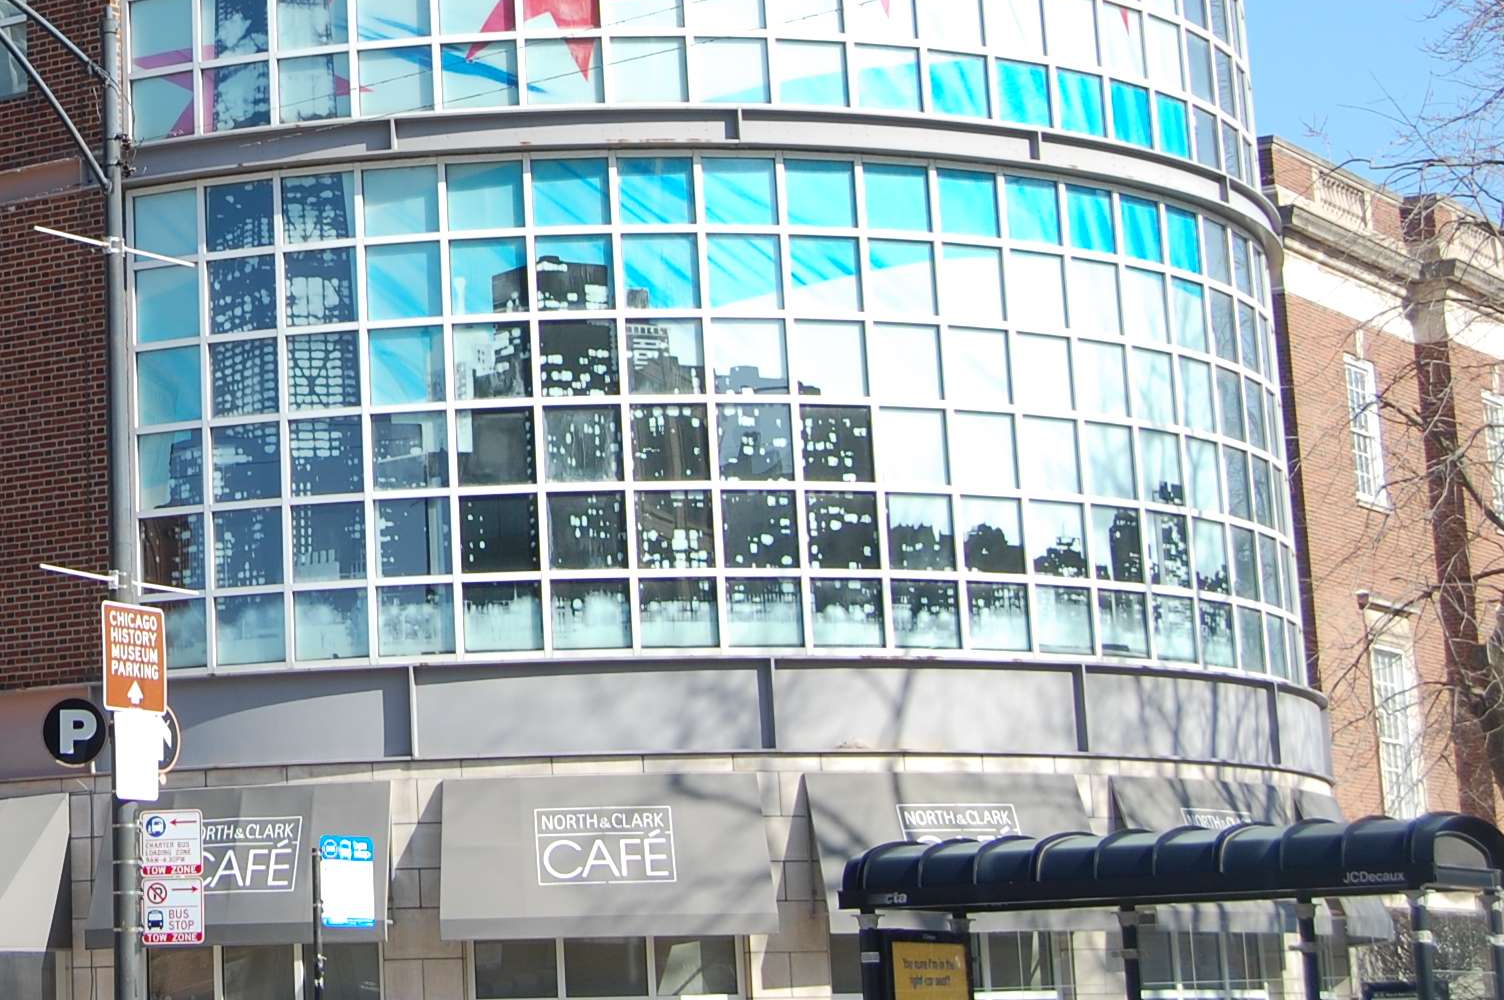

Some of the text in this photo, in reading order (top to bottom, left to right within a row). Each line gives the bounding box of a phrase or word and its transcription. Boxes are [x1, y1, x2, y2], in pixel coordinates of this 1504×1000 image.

[109, 610, 158, 631] CHICAGO
[110, 626, 158, 647] HISTORY
[111, 643, 159, 664] MUSEUM
[111, 660, 160, 681] PARKING
[59, 709, 97, 754] P
[543, 828, 670, 879] CAFÉ
[146, 865, 197, 875] TOW ZONE
[1343, 871, 1406, 884] JCDecaux
[885, 891, 908, 904] cta
[168, 908, 190, 919] BUS
[168, 920, 195, 931] STOP
[148, 932, 197, 943] TOW ZONE
